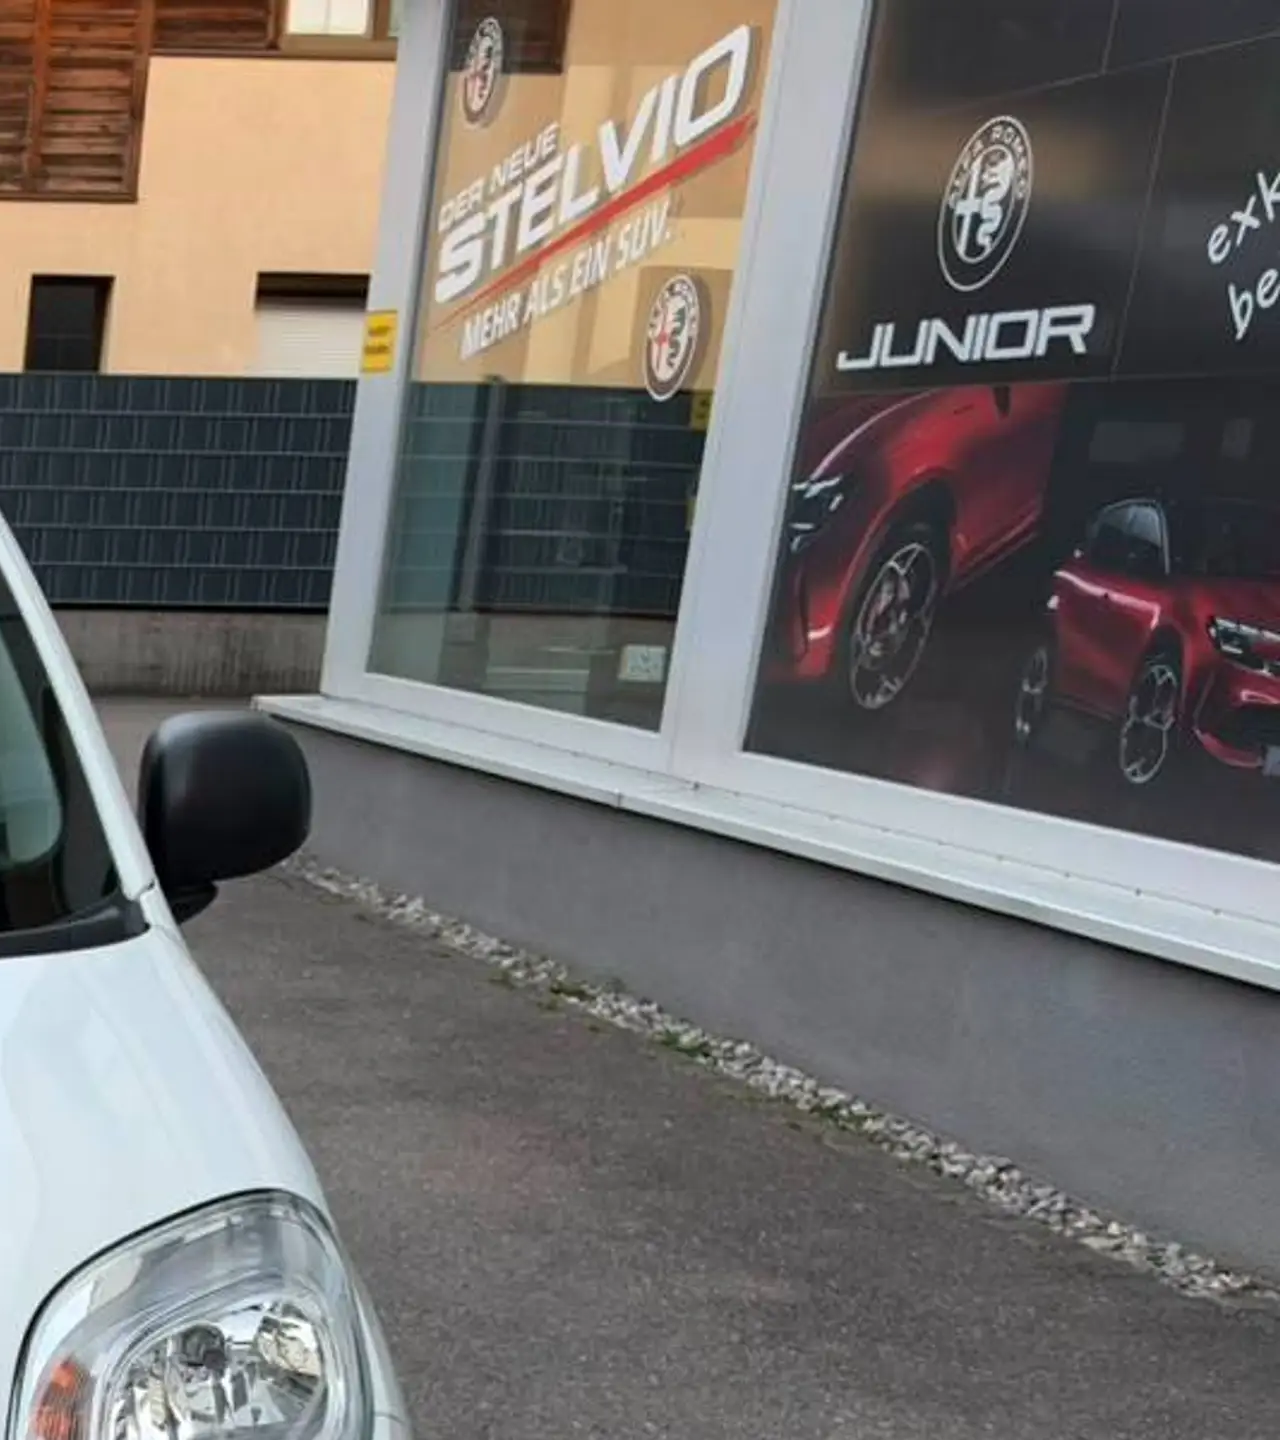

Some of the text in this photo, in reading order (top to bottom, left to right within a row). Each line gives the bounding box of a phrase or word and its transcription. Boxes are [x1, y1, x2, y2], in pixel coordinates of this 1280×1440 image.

[435, 24, 750, 303] STELVIO
[439, 121, 559, 232] DER NEUE
[459, 291, 523, 361] MEHR
[522, 263, 569, 324] ALS
[569, 232, 614, 294] EIN
[615, 199, 671, 269] SUV.
[835, 303, 1096, 371] JUNIOR
